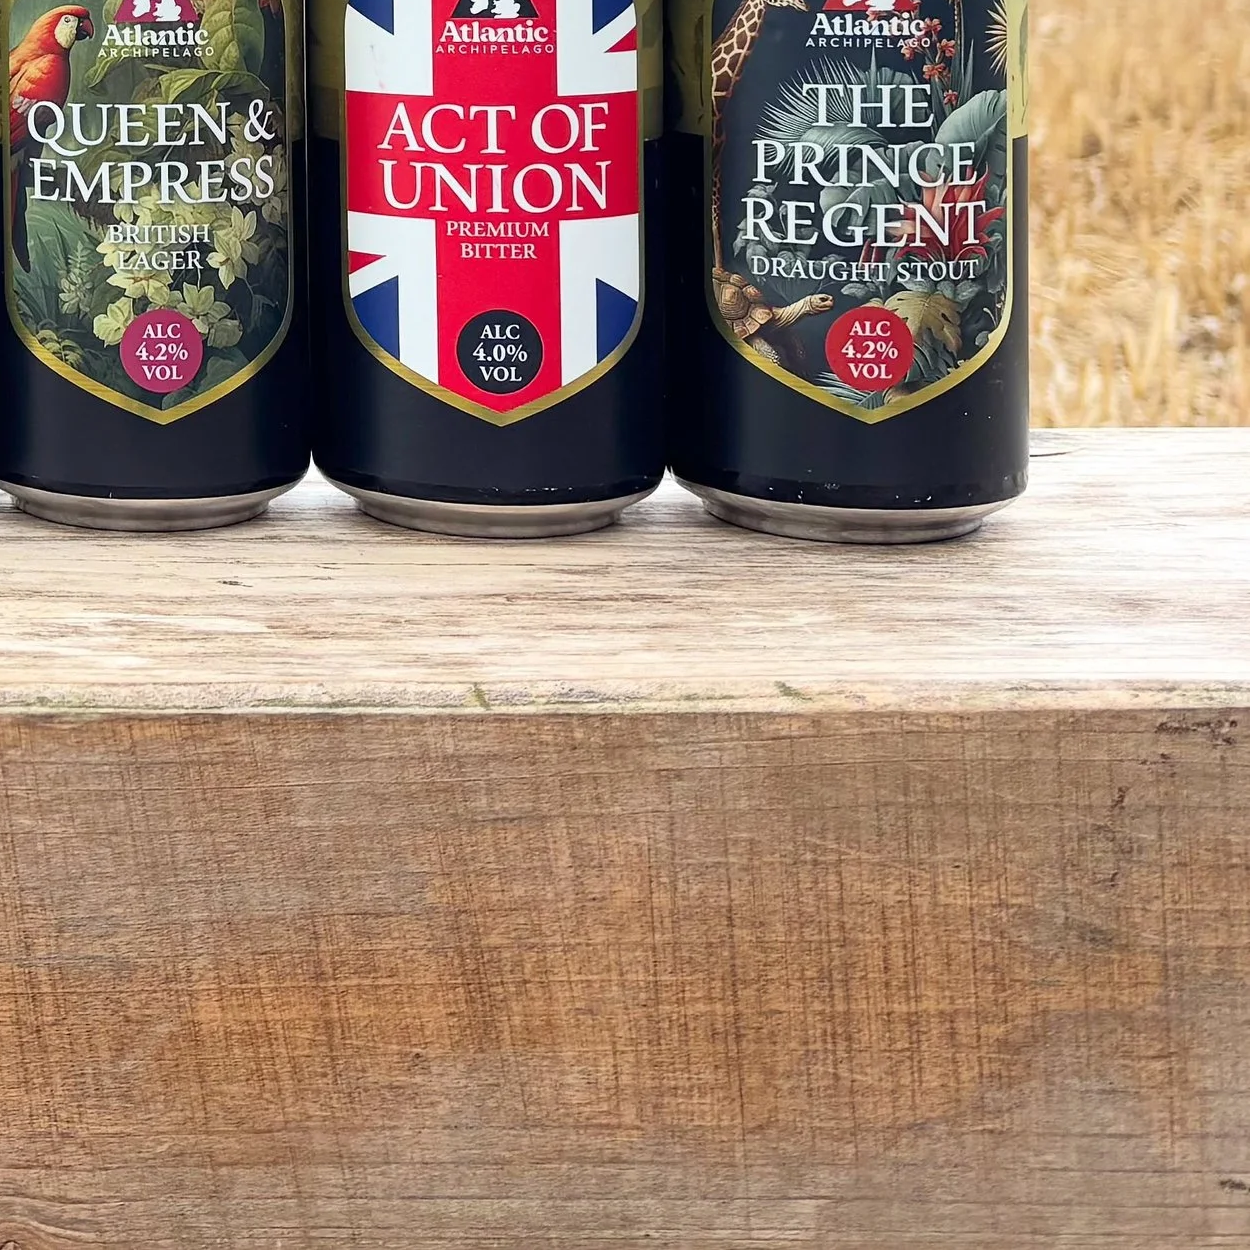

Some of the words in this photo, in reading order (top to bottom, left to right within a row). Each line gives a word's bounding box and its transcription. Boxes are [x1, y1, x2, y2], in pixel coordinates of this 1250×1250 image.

[440, 20, 549, 44] Atlantic
[809, 13, 926, 37] Atlantic
[102, 24, 208, 46] Atlantic
[805, 37, 931, 48] ARCHIPELAGO
[98, 47, 214, 57] ARCHIPELAGO
[436, 44, 555, 55] ARCHIPELAGO
[802, 83, 935, 128] THE
[27, 100, 230, 156] QUEEN
[243, 98, 276, 141] &
[378, 102, 516, 153] ACT
[532, 102, 610, 152] OF
[751, 139, 977, 188] PRINCE
[29, 155, 275, 205] EMPRESS
[378, 159, 611, 214] UNION
[446, 221, 550, 238] PREMIUM
[740, 198, 986, 247] REGENT
[108, 223, 210, 245] BRITISH
[117, 250, 204, 270] LAGER
[461, 243, 538, 260] BITTER
[750, 256, 891, 283] DRAUGHT
[897, 260, 980, 282] STOUT
[143, 323, 181, 339] ALC
[480, 325, 520, 340] ALC
[849, 321, 891, 338] ALC
[135, 343, 189, 361] 4.2%
[472, 344, 528, 362] 4.0%
[841, 341, 898, 360] 4.2%
[142, 365, 183, 381] VOL
[479, 366, 522, 382] VOL
[848, 363, 892, 379] VOL
